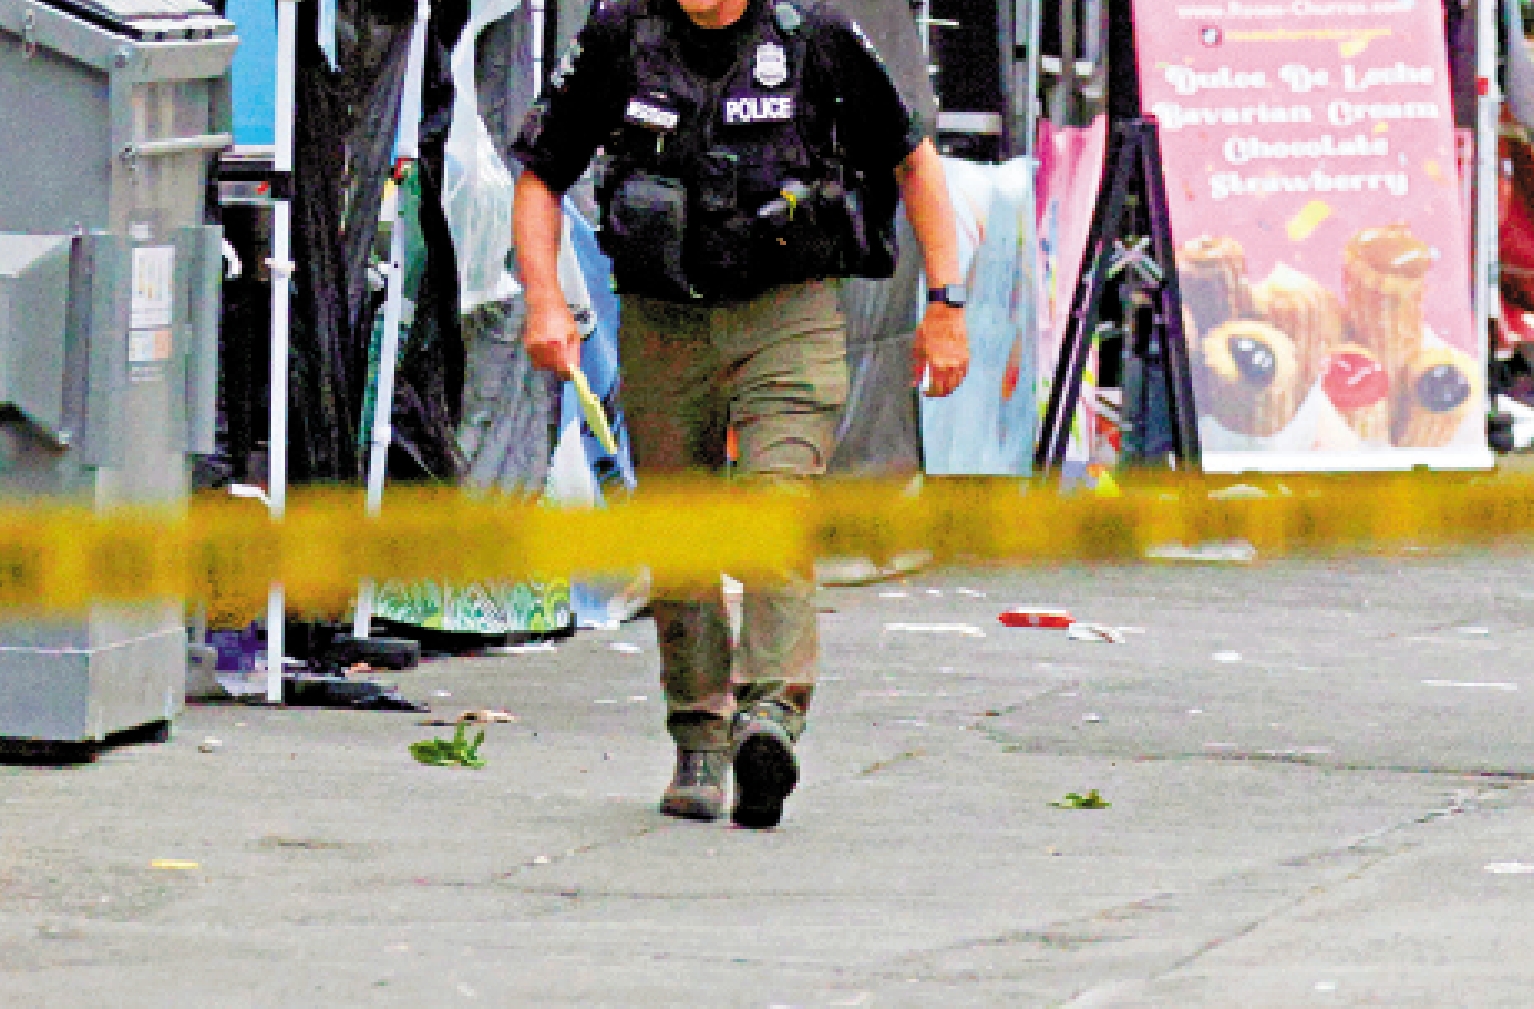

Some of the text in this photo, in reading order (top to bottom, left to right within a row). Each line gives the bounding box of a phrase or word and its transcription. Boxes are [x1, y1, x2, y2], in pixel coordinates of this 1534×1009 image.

[1279, 63, 1329, 93] De
[725, 96, 792, 123] POLICE
[1152, 100, 1312, 130] Bavarian
[1223, 135, 1389, 163] Chocolate
[1208, 167, 1409, 199] Strawberry
